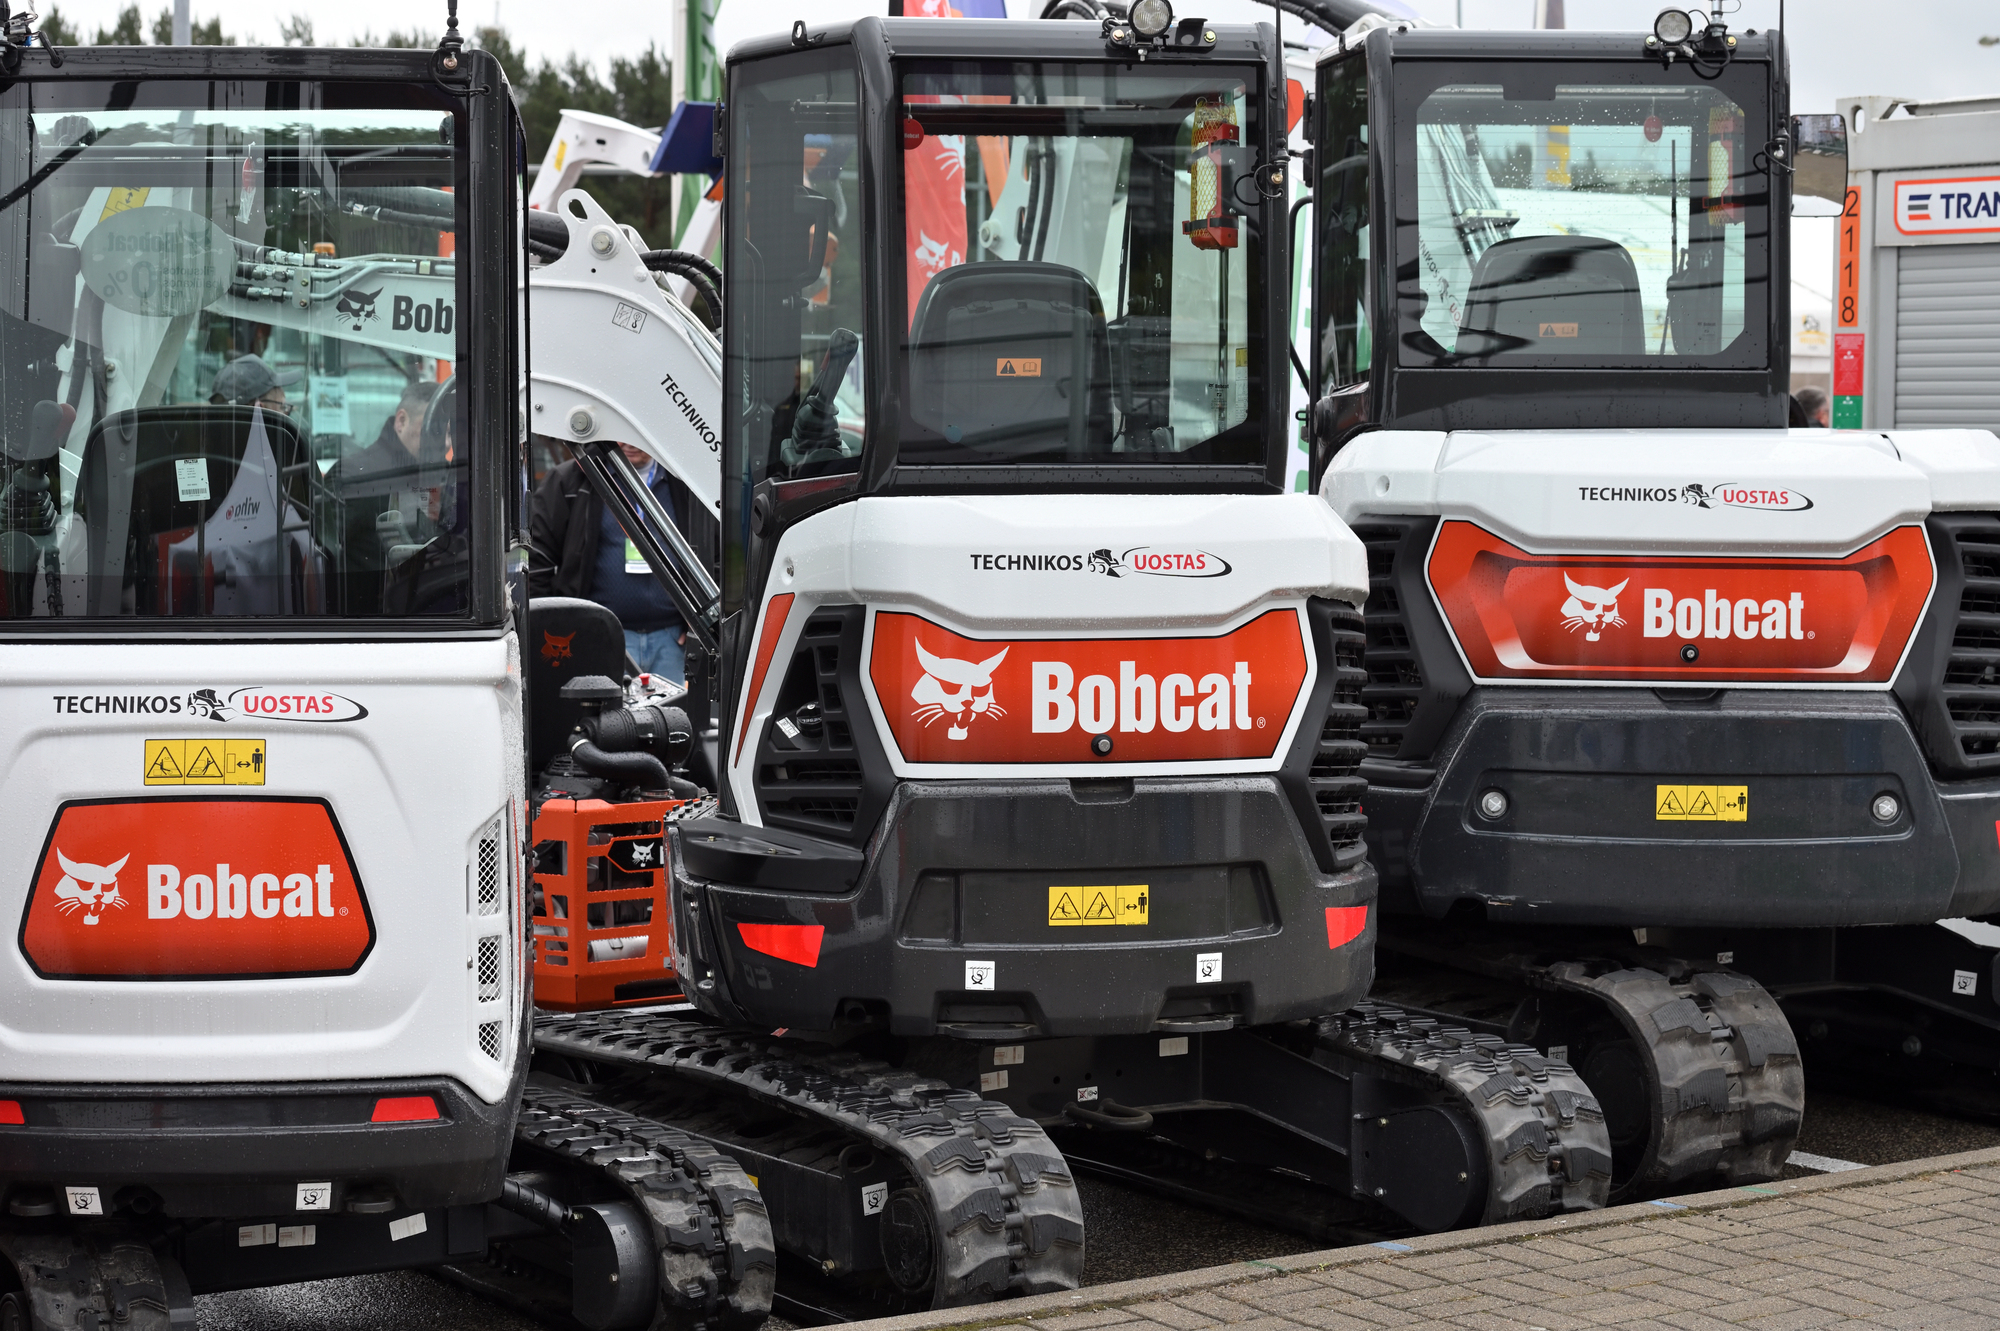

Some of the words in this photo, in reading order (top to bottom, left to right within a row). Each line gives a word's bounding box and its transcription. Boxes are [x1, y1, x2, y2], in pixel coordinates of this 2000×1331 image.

[1940, 191, 2000, 219] TRAN
[661, 373, 722, 452] TECHNIKOS
[1579, 487, 1677, 502] TECHNIKOS
[1723, 489, 1789, 505] UOSTAS
[971, 555, 1083, 571] TECHNIKOS
[1134, 553, 1206, 571] UOSTAS
[1643, 588, 1805, 641] Bobcat
[53, 695, 182, 714] TECHNIKOS
[243, 695, 334, 714] UOSTAS
[1031, 660, 1252, 734] Bobcat
[147, 863, 335, 920] Bobcat
